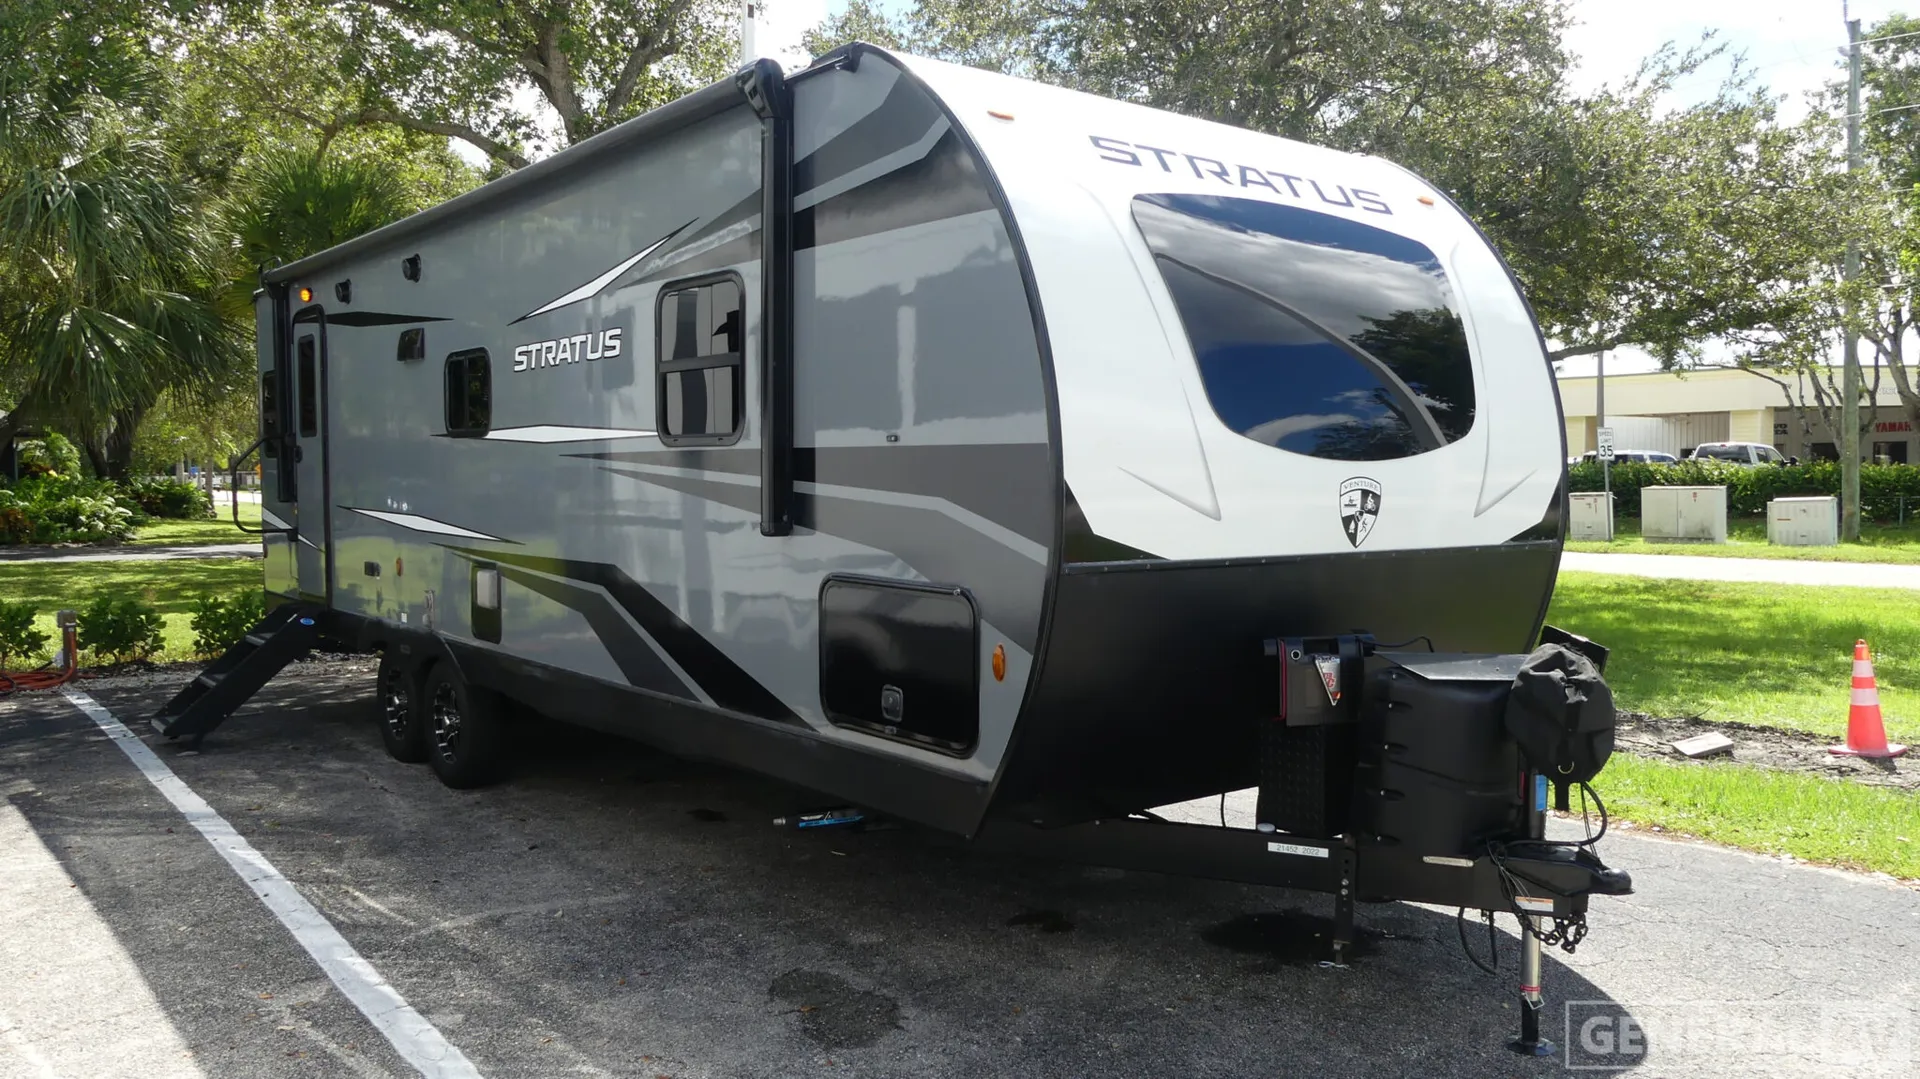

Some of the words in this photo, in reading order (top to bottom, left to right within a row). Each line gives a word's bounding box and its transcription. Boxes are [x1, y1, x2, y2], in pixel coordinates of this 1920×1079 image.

[1089, 135, 1393, 215] STRATUS
[513, 327, 622, 372] STRATUS
[1875, 421, 1912, 433] YAMAH
[1600, 445, 1613, 457] 35
[1343, 480, 1379, 490] VENTURE
[1276, 844, 1299, 853] 21452
[1302, 846, 1320, 856] 2022
